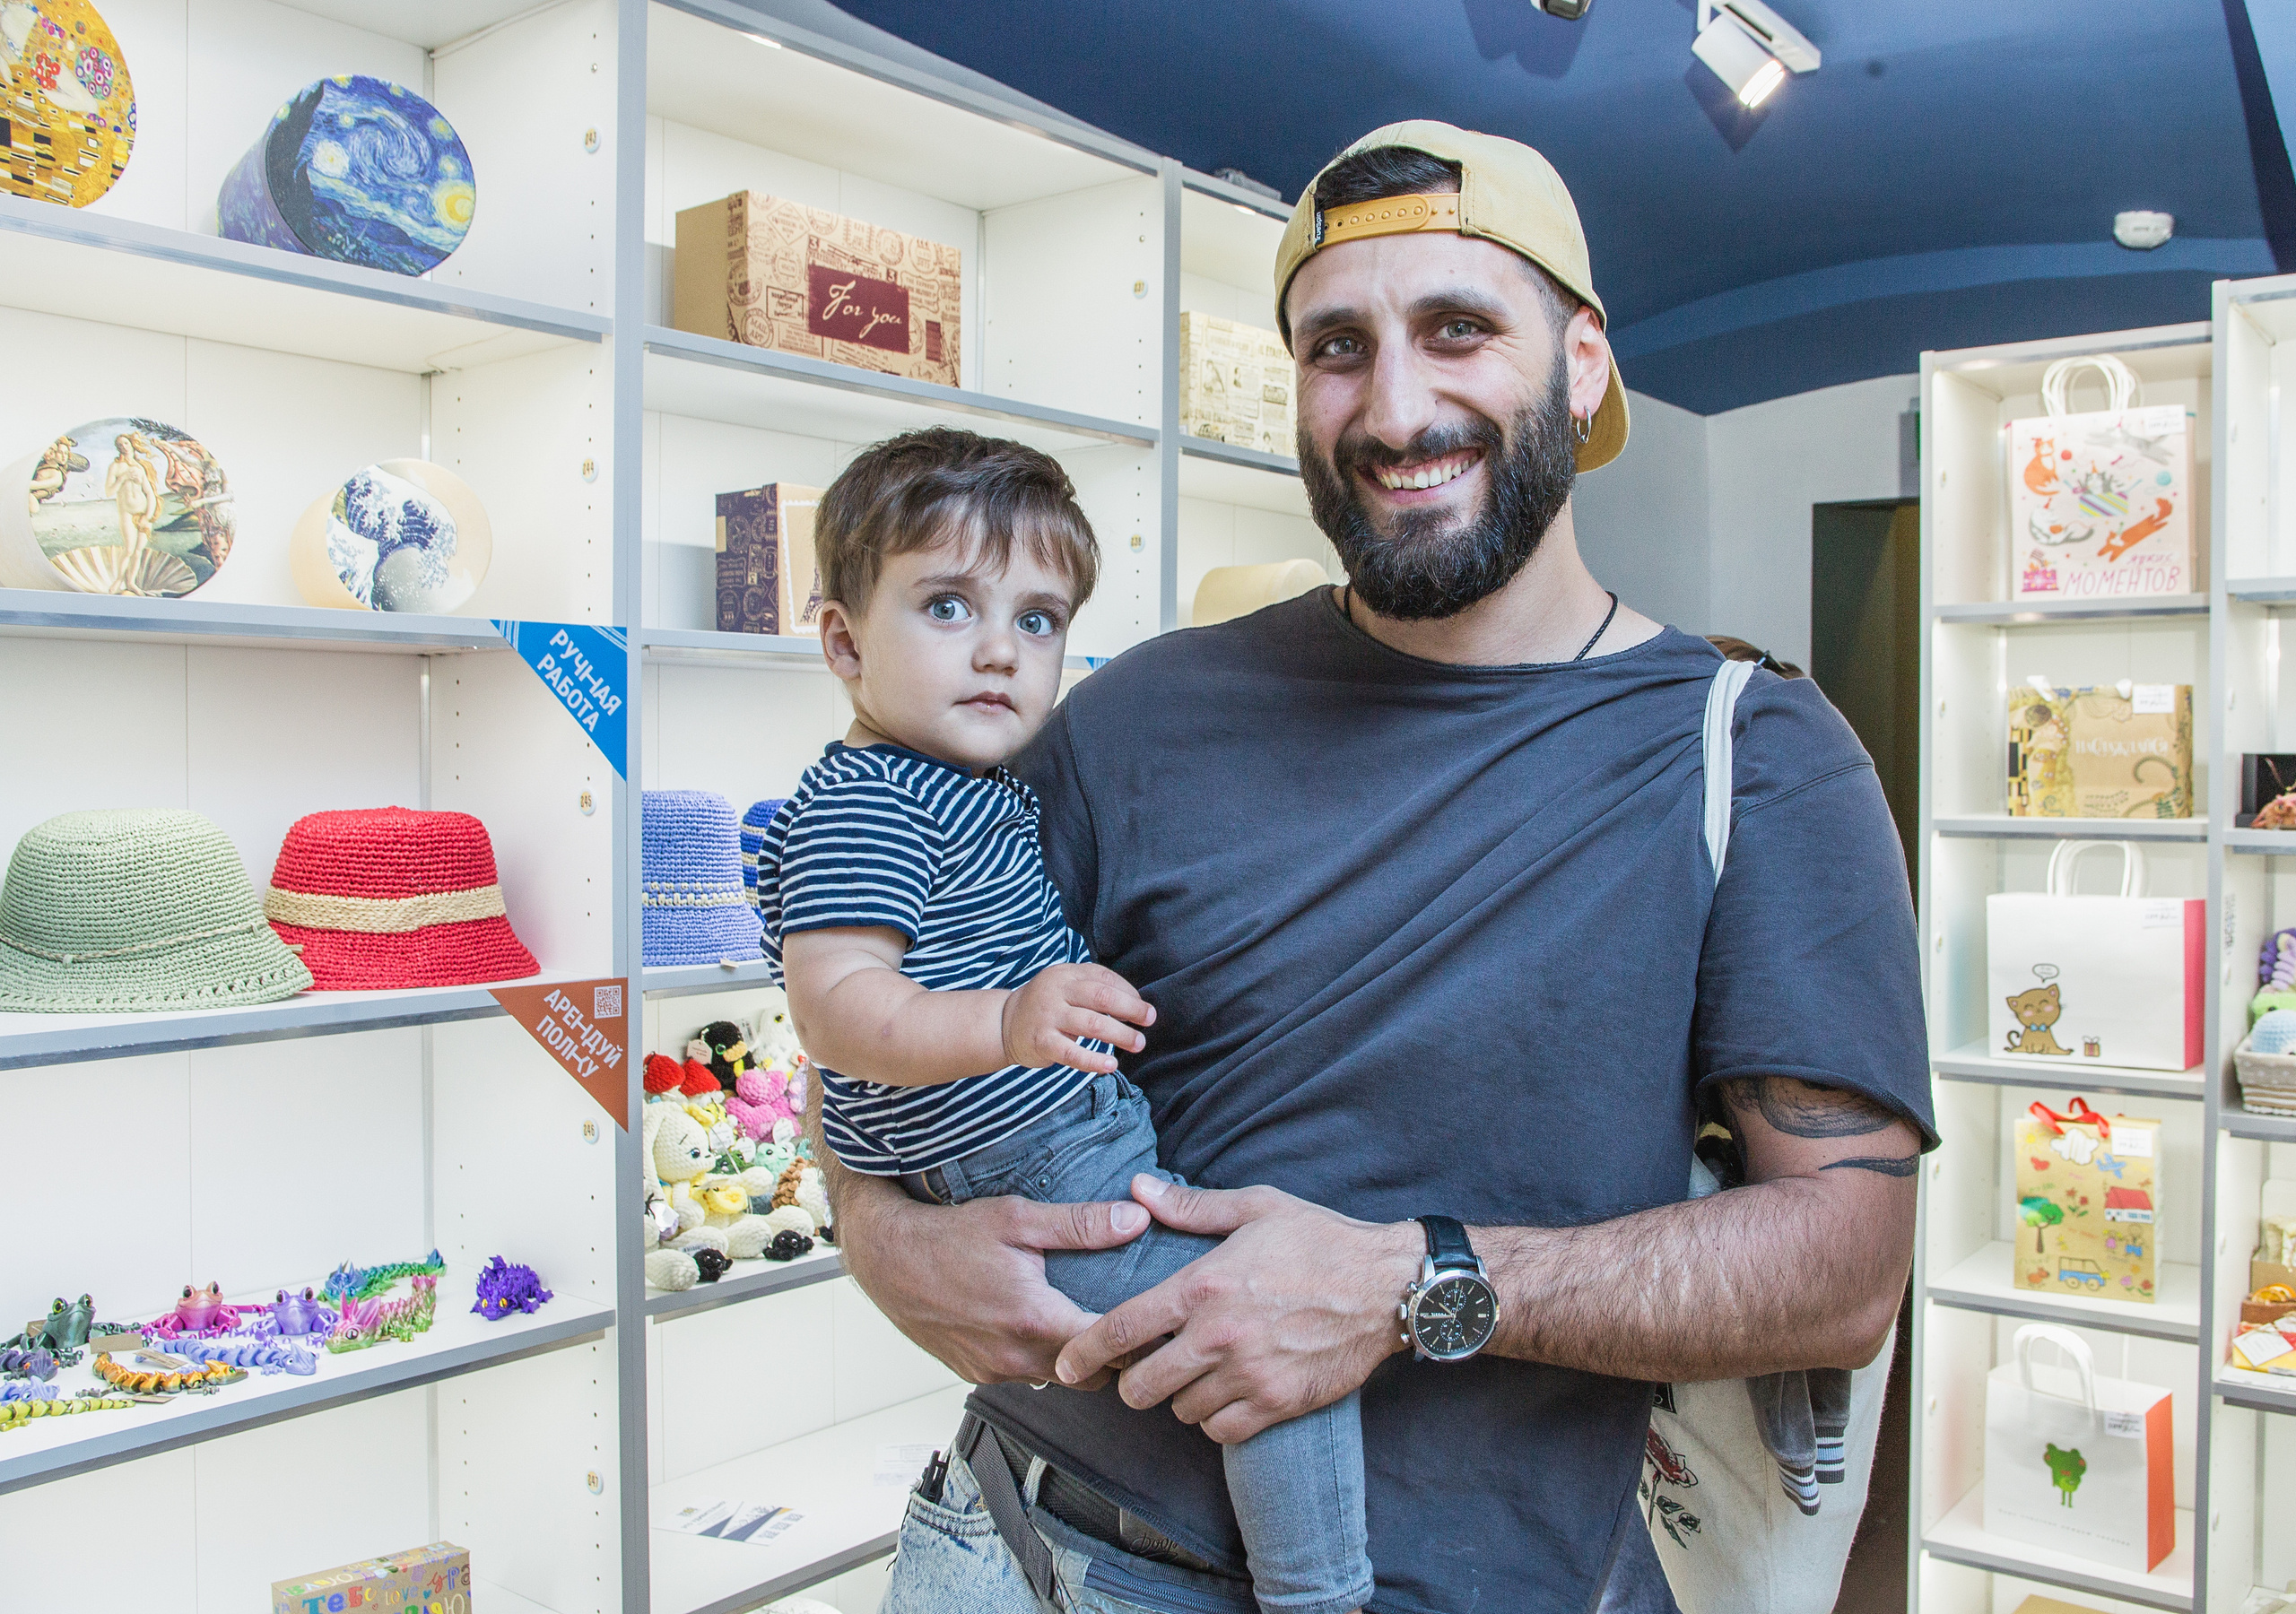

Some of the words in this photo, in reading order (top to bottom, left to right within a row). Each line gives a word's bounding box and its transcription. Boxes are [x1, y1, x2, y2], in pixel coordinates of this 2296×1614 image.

[822, 280, 863, 320] For
[859, 306, 902, 339] you
[2063, 566, 2181, 595] МОМЕНТОВ
[536, 653, 600, 733] РАБОТА
[549, 629, 622, 716] РУЧНАЯ
[580, 794, 592, 808] 245
[535, 1015, 600, 1078] ПОЛКУ
[544, 988, 623, 1069] АРЕНДУЙ
[583, 1124, 595, 1137] 246
[587, 1473, 599, 1488] 247
